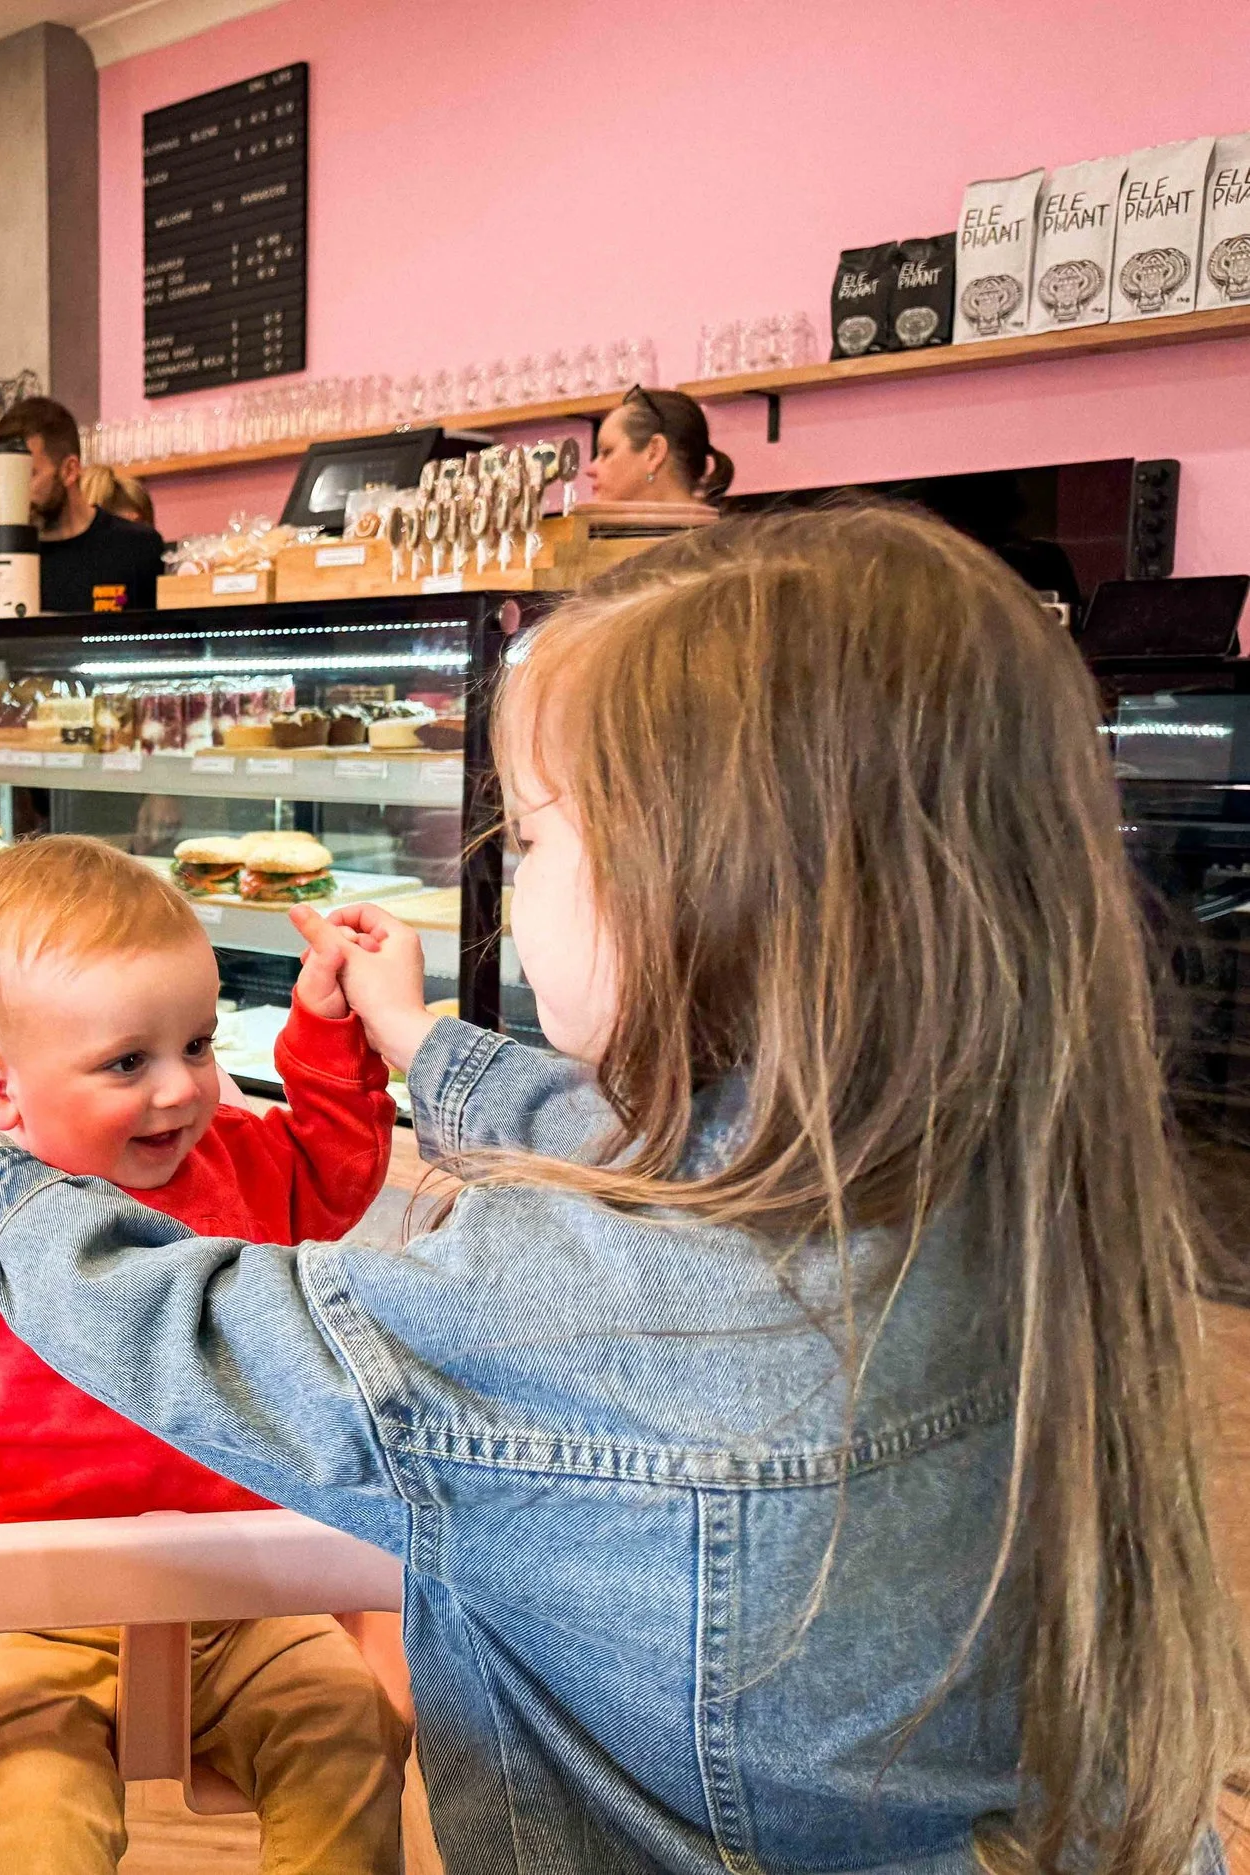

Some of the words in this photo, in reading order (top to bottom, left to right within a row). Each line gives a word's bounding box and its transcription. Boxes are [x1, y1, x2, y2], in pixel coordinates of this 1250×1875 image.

[1045, 191, 1087, 215] ELE
[1126, 176, 1169, 201] ELE
[964, 204, 1003, 229] ELE
[1042, 204, 1110, 237] PHANT
[1124, 189, 1195, 224] PHANT
[961, 218, 1026, 251] PHANT
